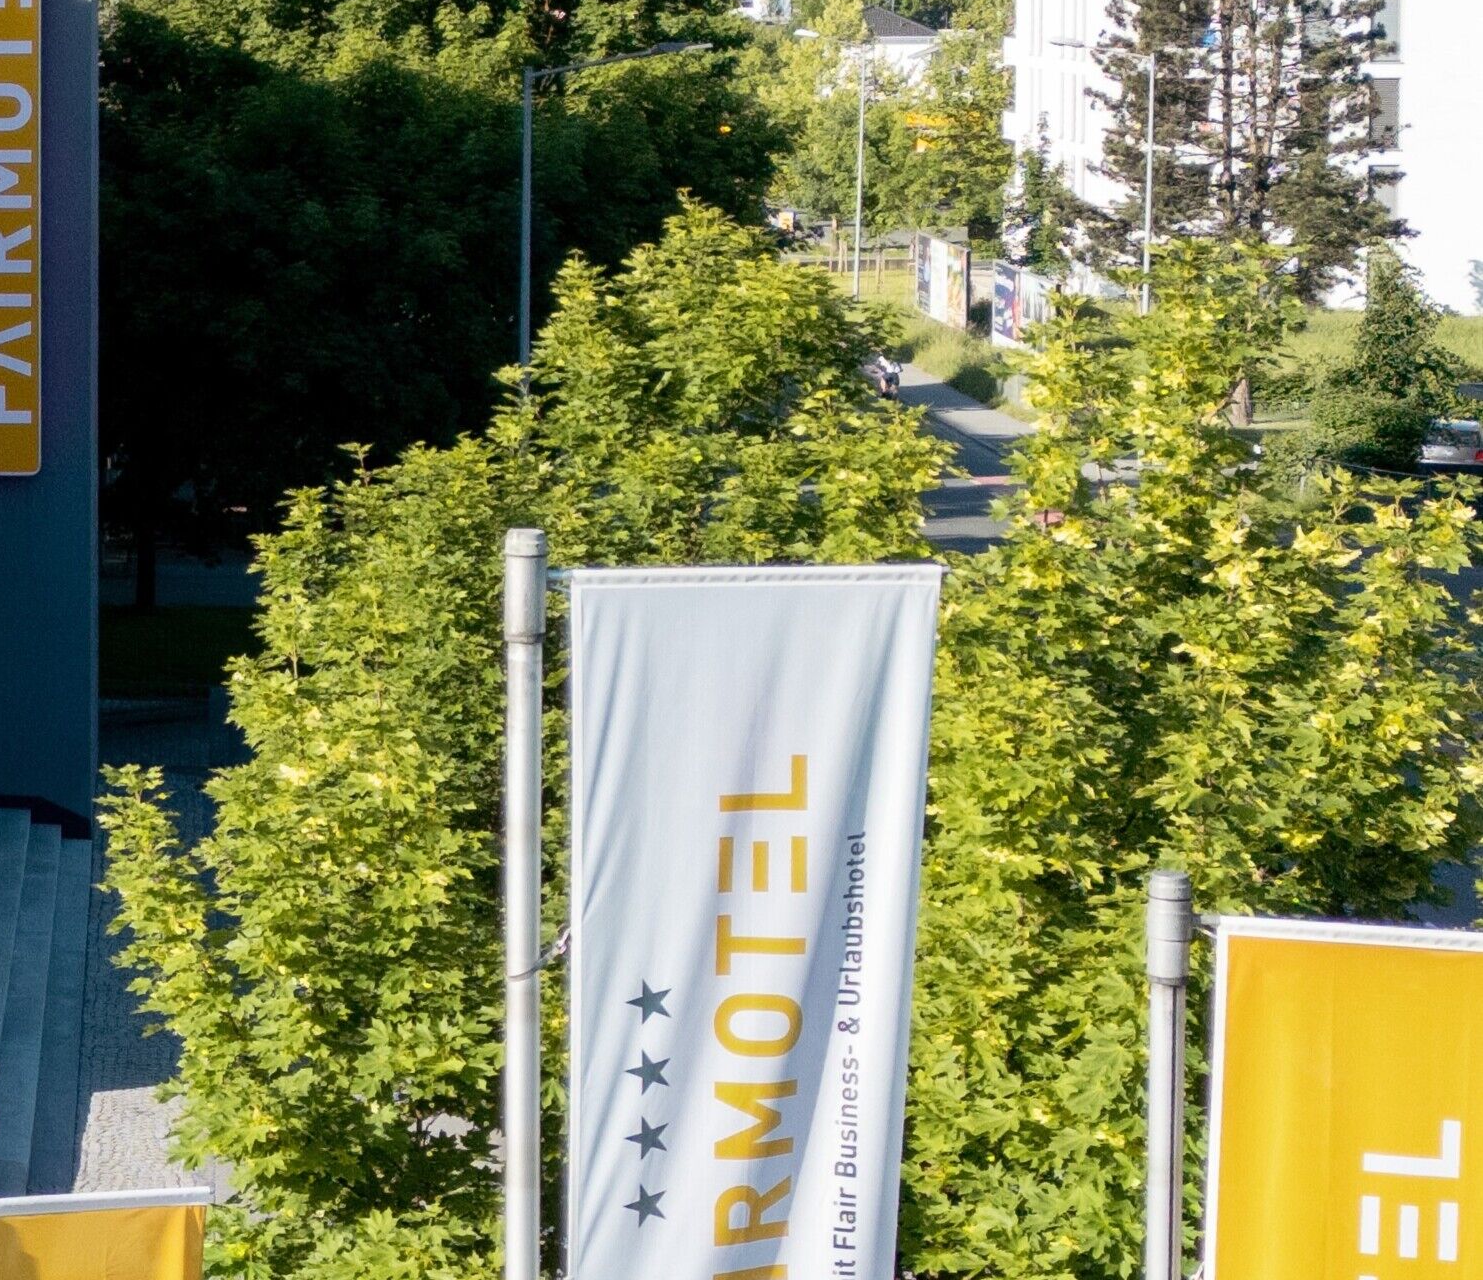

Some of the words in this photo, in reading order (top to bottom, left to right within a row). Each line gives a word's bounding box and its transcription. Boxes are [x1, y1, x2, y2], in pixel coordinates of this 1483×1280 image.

[837, 831, 867, 1006] Urlaubshotel
[837, 1017, 861, 1035] &
[834, 1044, 859, 1178] Business-
[833, 1186, 857, 1250] Flair
